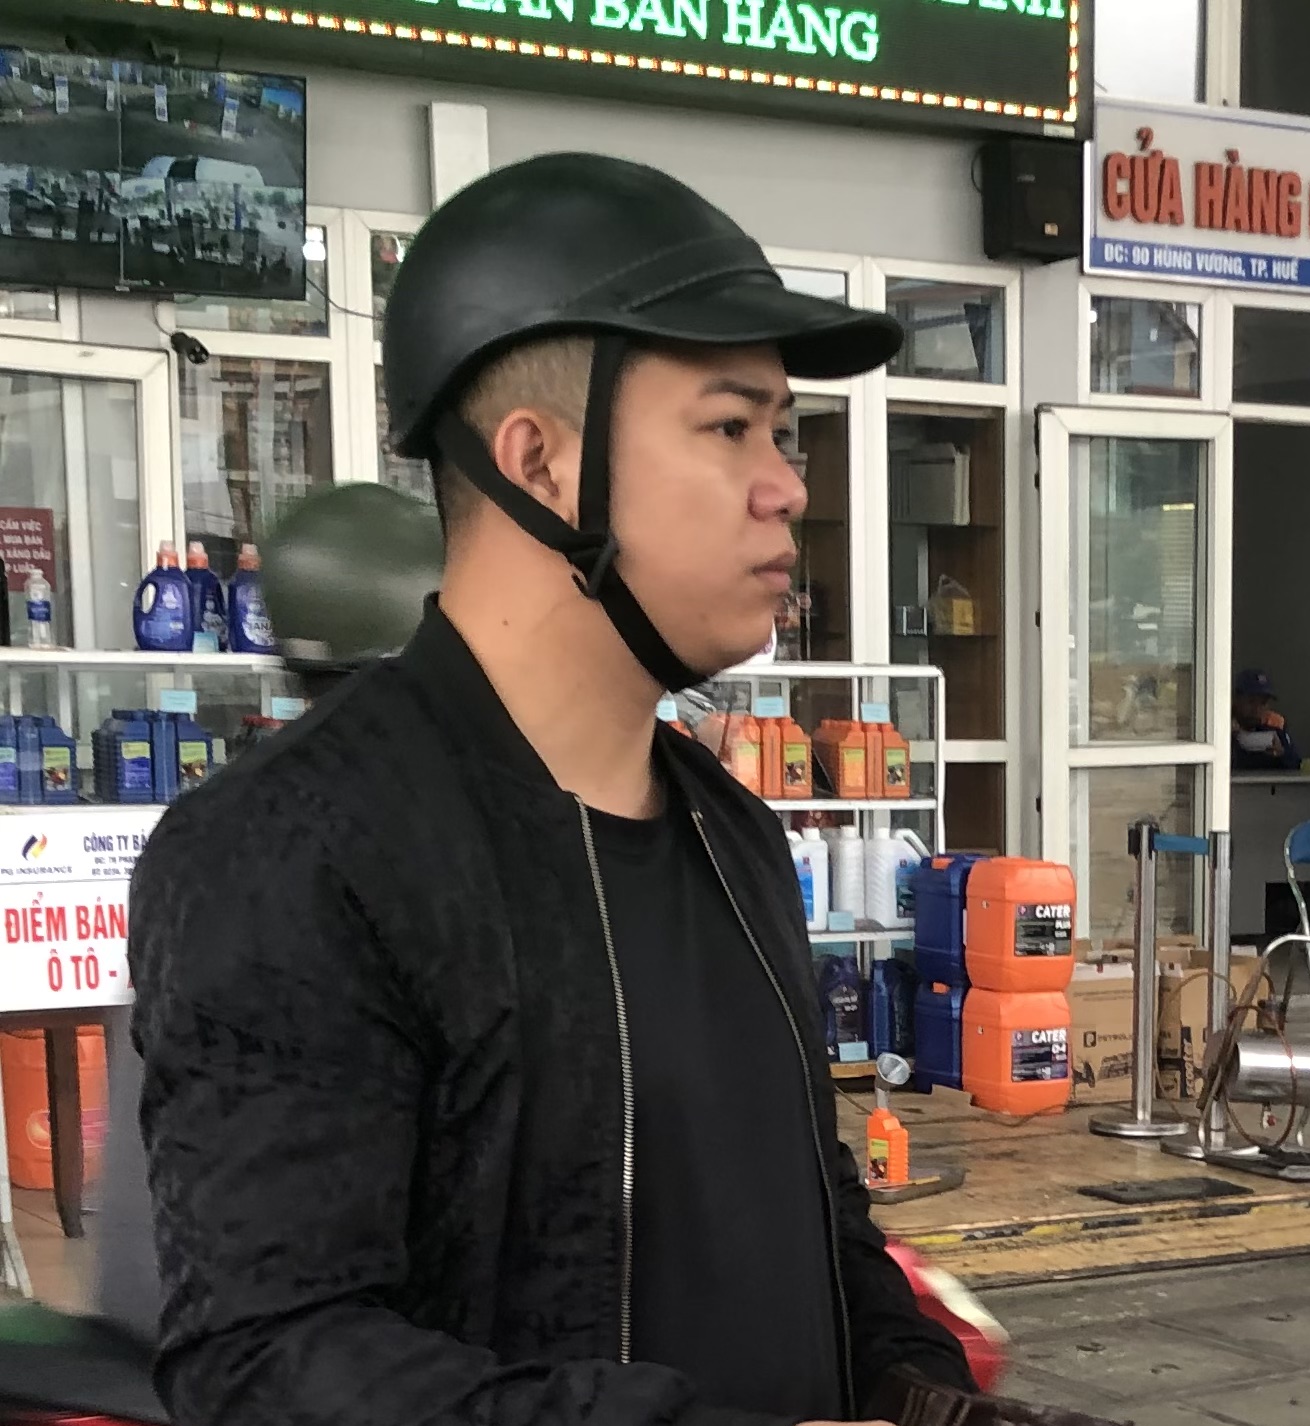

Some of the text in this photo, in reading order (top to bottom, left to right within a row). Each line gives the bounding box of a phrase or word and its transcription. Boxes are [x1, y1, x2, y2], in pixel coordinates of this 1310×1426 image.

[1103, 127, 1184, 226] CỬA
[1194, 148, 1301, 238] HÀNG
[83, 832, 113, 852] CÔNG
[116, 834, 129, 851] TY
[5, 891, 67, 944] ĐIỂM
[1035, 904, 1071, 918] CATER
[47, 949, 64, 992] Ô
[70, 947, 99, 990] TÔ
[1031, 1028, 1067, 1044] CATER
